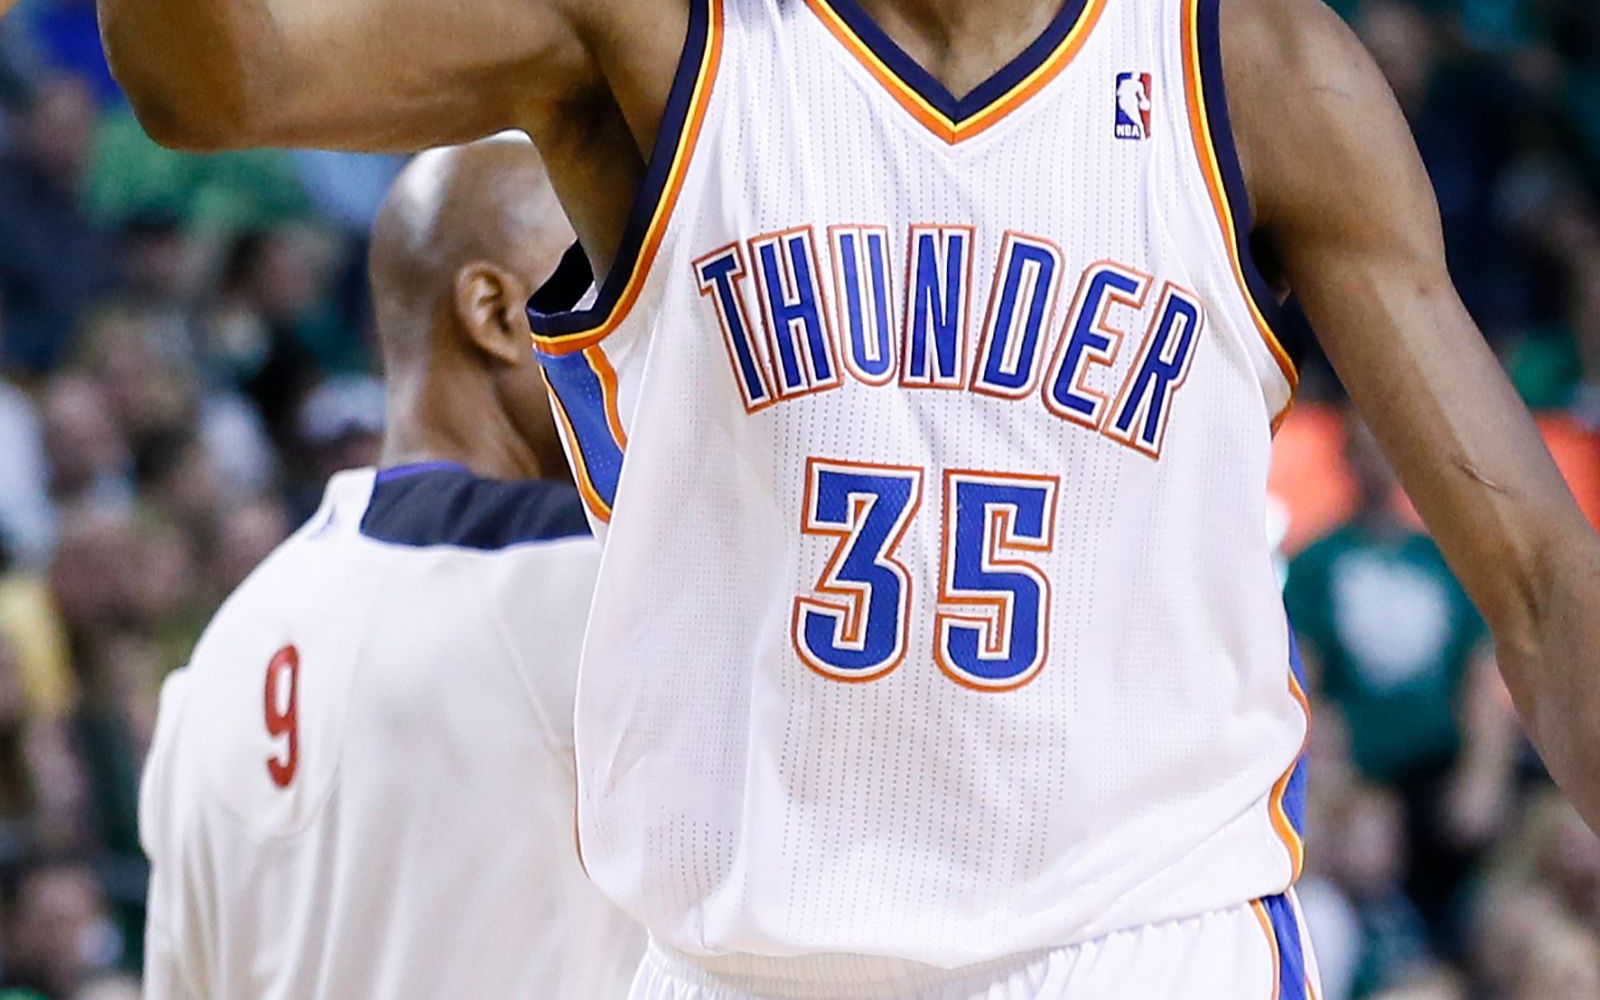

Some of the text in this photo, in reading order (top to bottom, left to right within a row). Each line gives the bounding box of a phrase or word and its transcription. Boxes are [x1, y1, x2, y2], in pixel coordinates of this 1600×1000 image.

[1116, 123, 1140, 137] NBA
[692, 224, 1205, 461] THUNDER
[791, 457, 1061, 692] 35
[264, 645, 299, 788] 9
